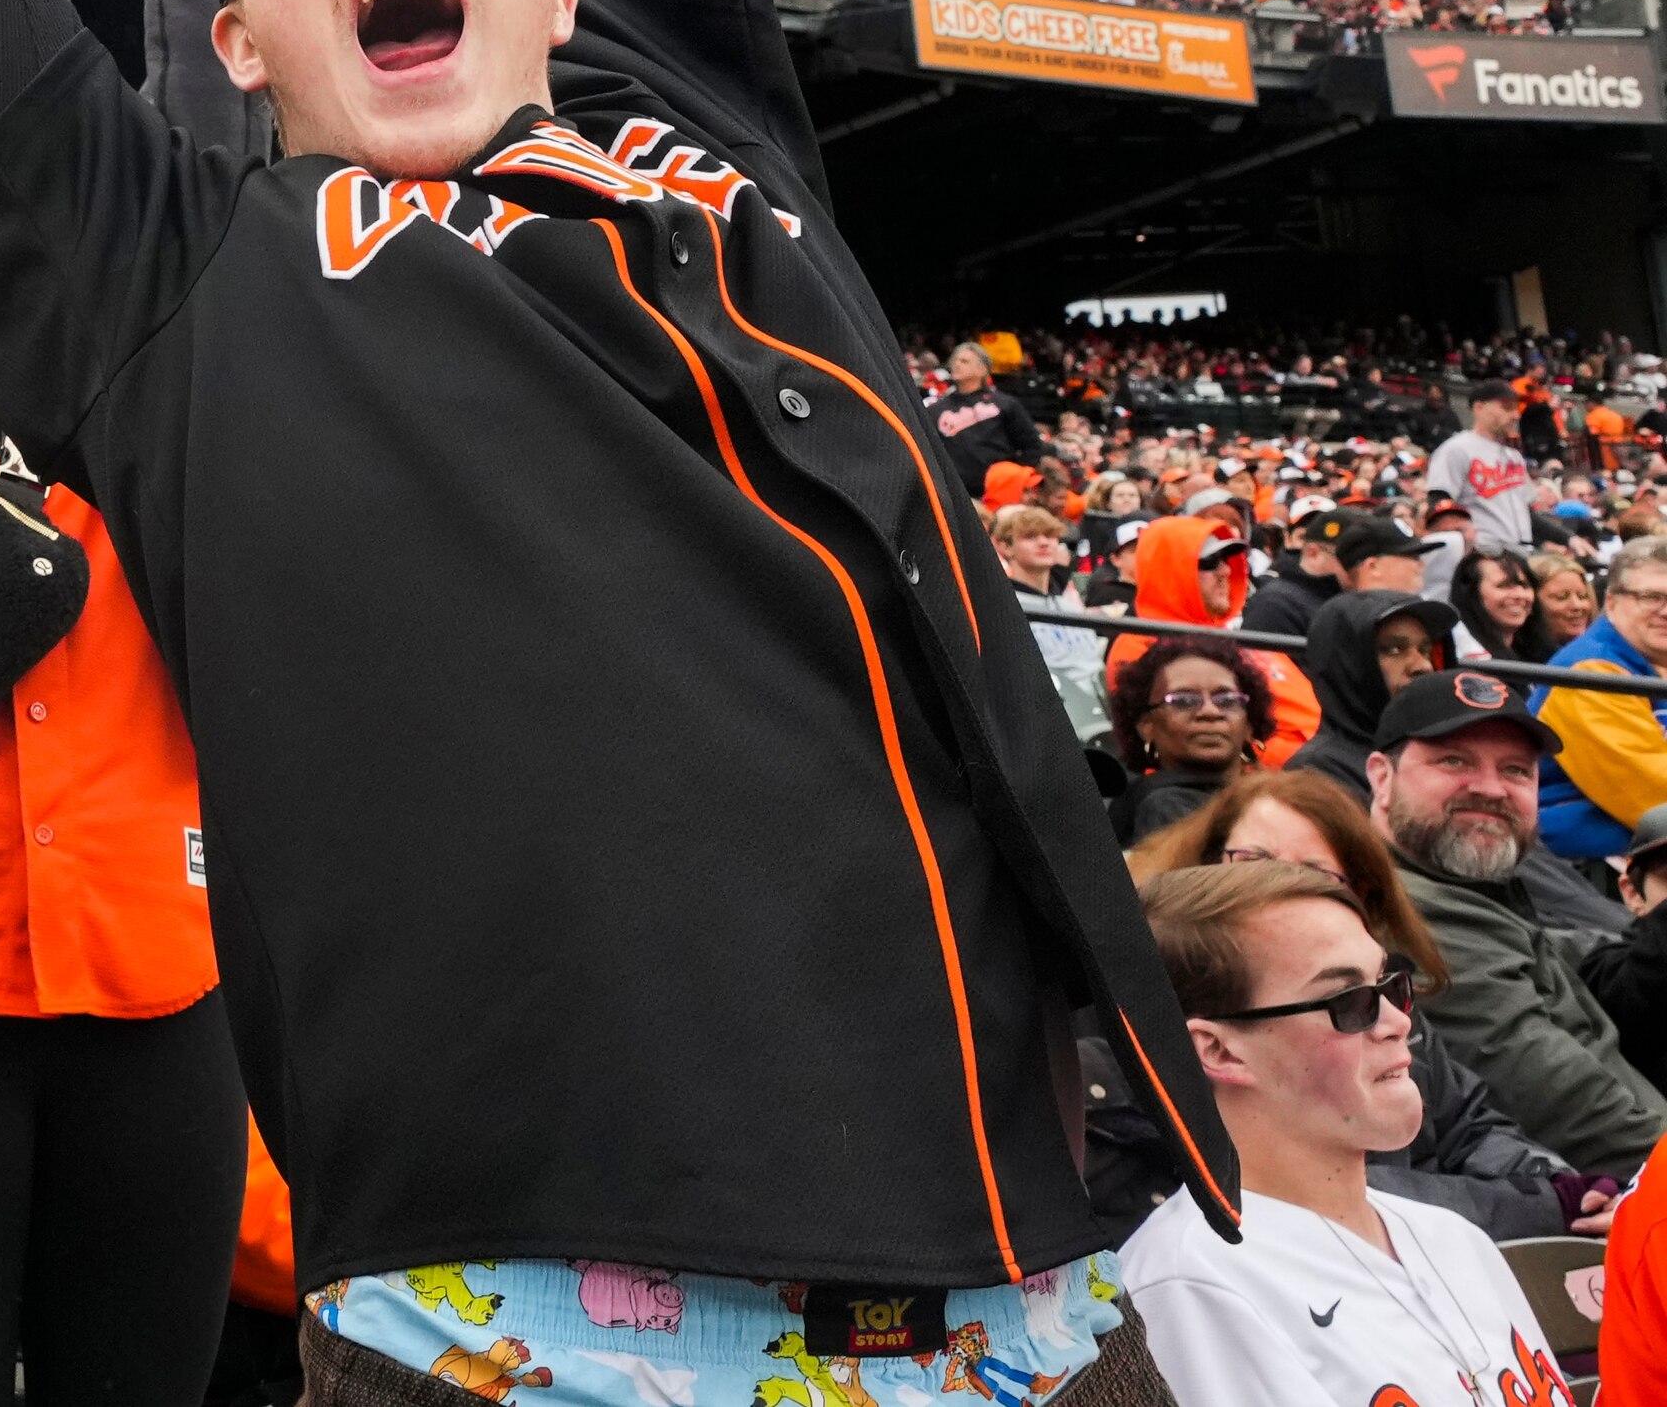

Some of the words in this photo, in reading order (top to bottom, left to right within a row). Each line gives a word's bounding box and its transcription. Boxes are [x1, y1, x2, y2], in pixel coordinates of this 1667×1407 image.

[1004, 5, 1090, 51] CHEER
[1091, 15, 1159, 61] FREE
[1473, 58, 1644, 109] Fanatics
[848, 1297, 915, 1331] TOY
[855, 1332, 907, 1347] STORY
